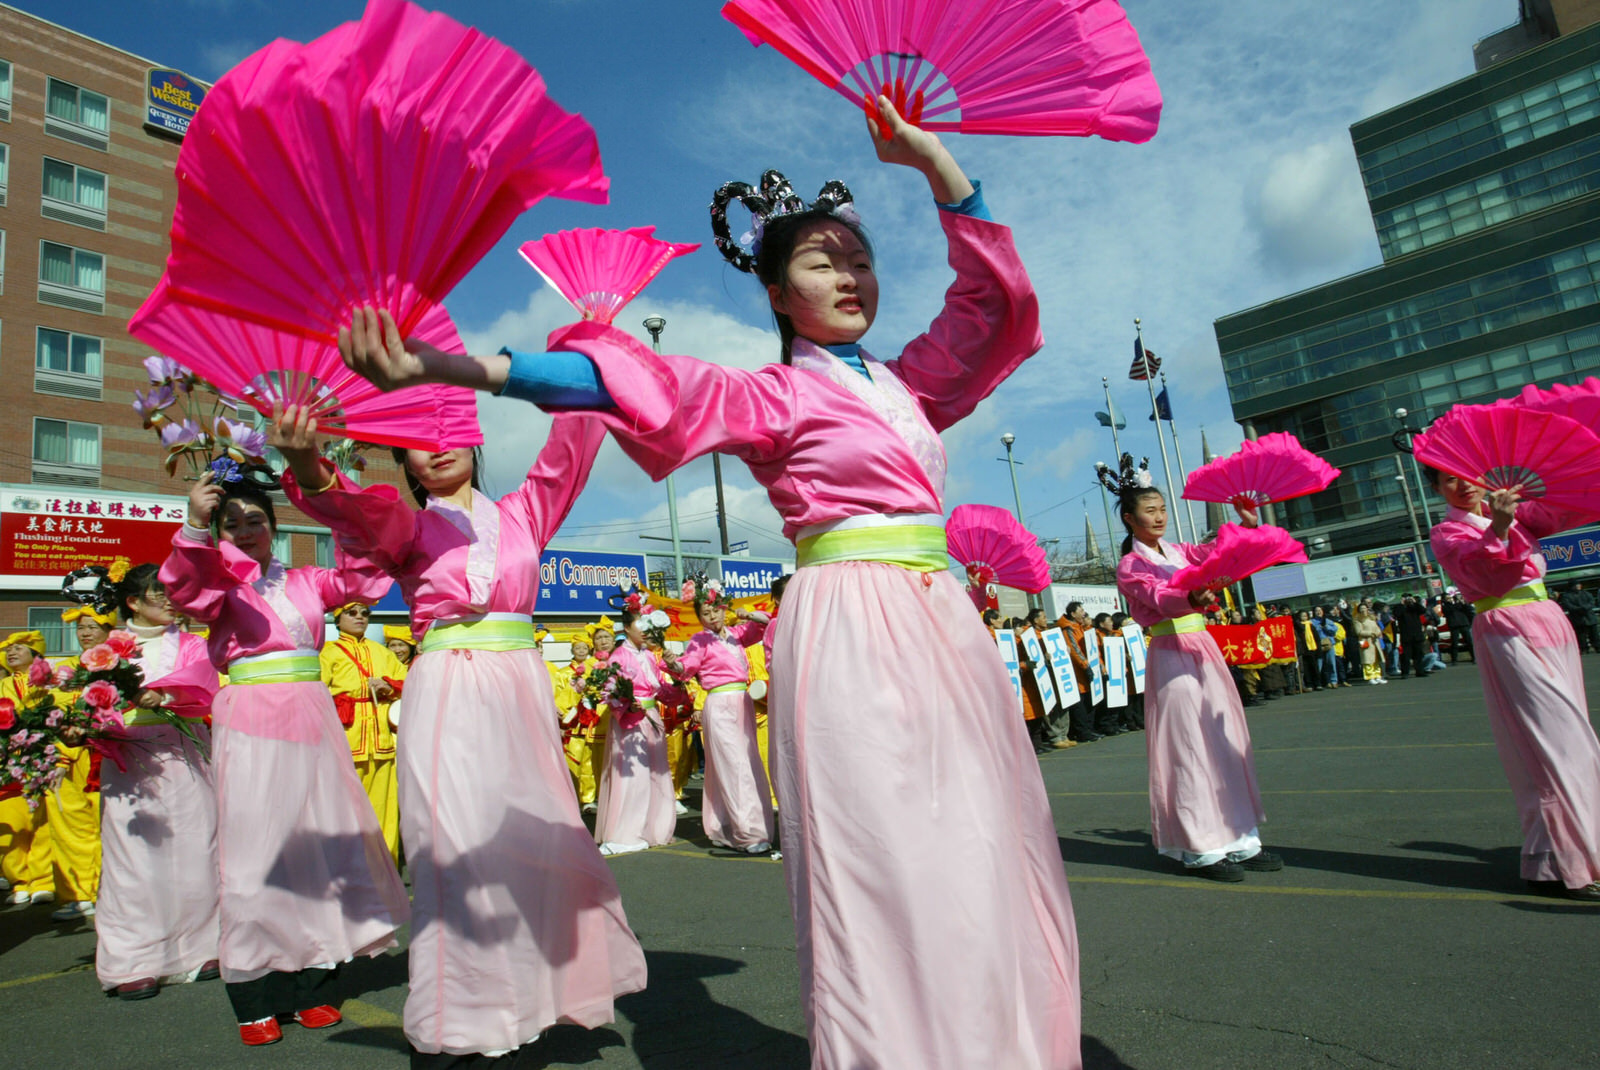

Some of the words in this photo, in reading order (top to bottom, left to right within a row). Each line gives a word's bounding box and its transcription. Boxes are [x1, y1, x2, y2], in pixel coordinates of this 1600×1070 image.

[163, 81, 192, 101] Best
[149, 107, 177, 121] QUEEN
[164, 120, 188, 132] HOTE
[45, 499, 184, 519] 法拉盛購物中心
[26, 516, 105, 534] 美食新天地
[14, 532, 62, 543] Flushing
[64, 534, 91, 544] Food
[92, 536, 121, 545] Court
[32, 543, 50, 552] Only
[1541, 544, 1574, 562] nity
[64, 554, 98, 562] anything
[541, 559, 557, 584] of
[559, 557, 640, 588] Commerce
